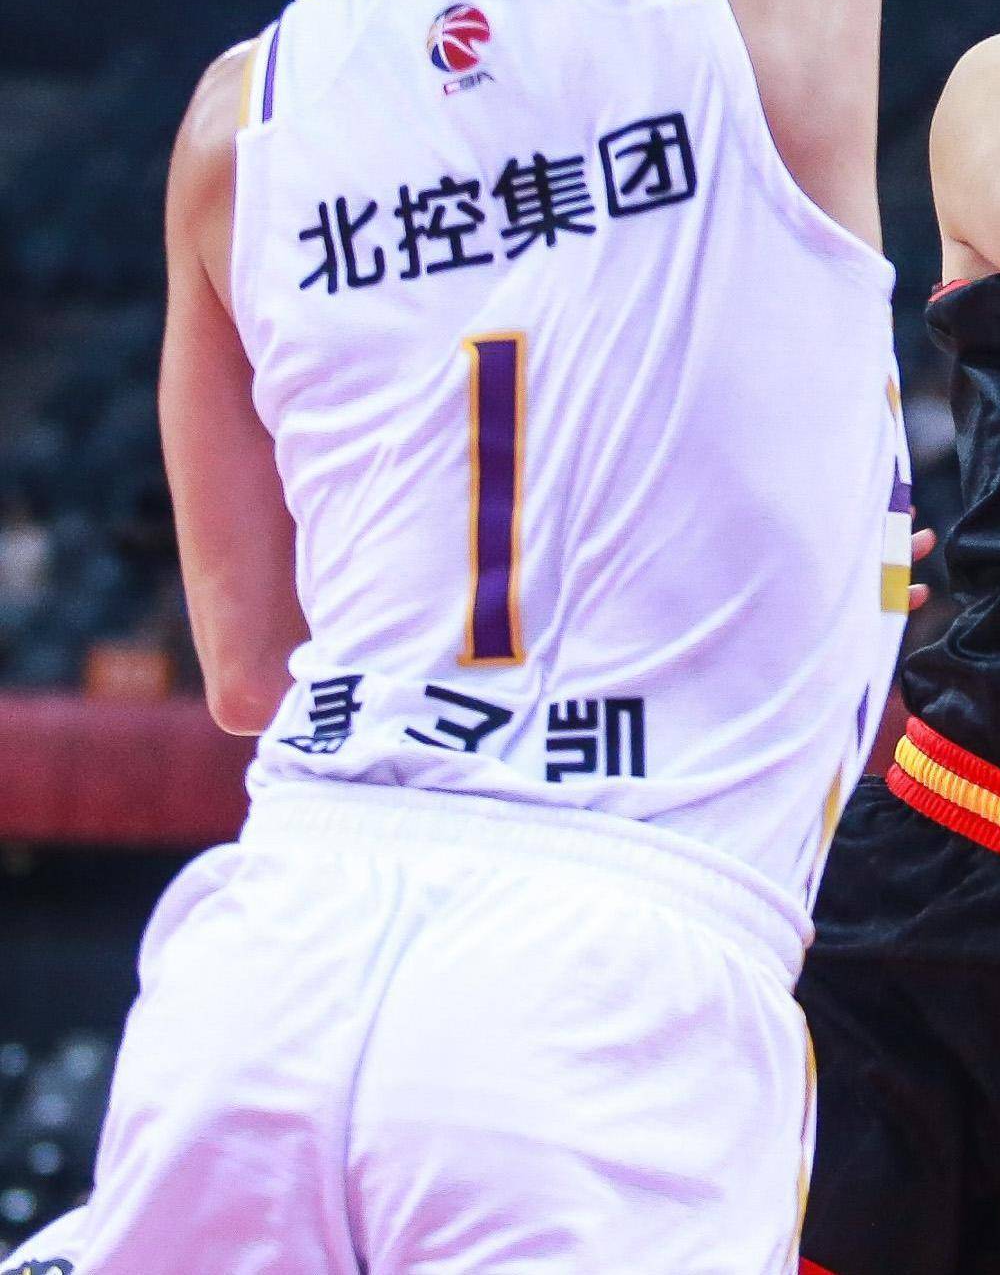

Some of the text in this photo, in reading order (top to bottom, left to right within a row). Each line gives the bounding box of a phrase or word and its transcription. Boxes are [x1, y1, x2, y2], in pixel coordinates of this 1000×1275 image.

[299, 112, 697, 294] 北控集团
[457, 331, 527, 668] 1
